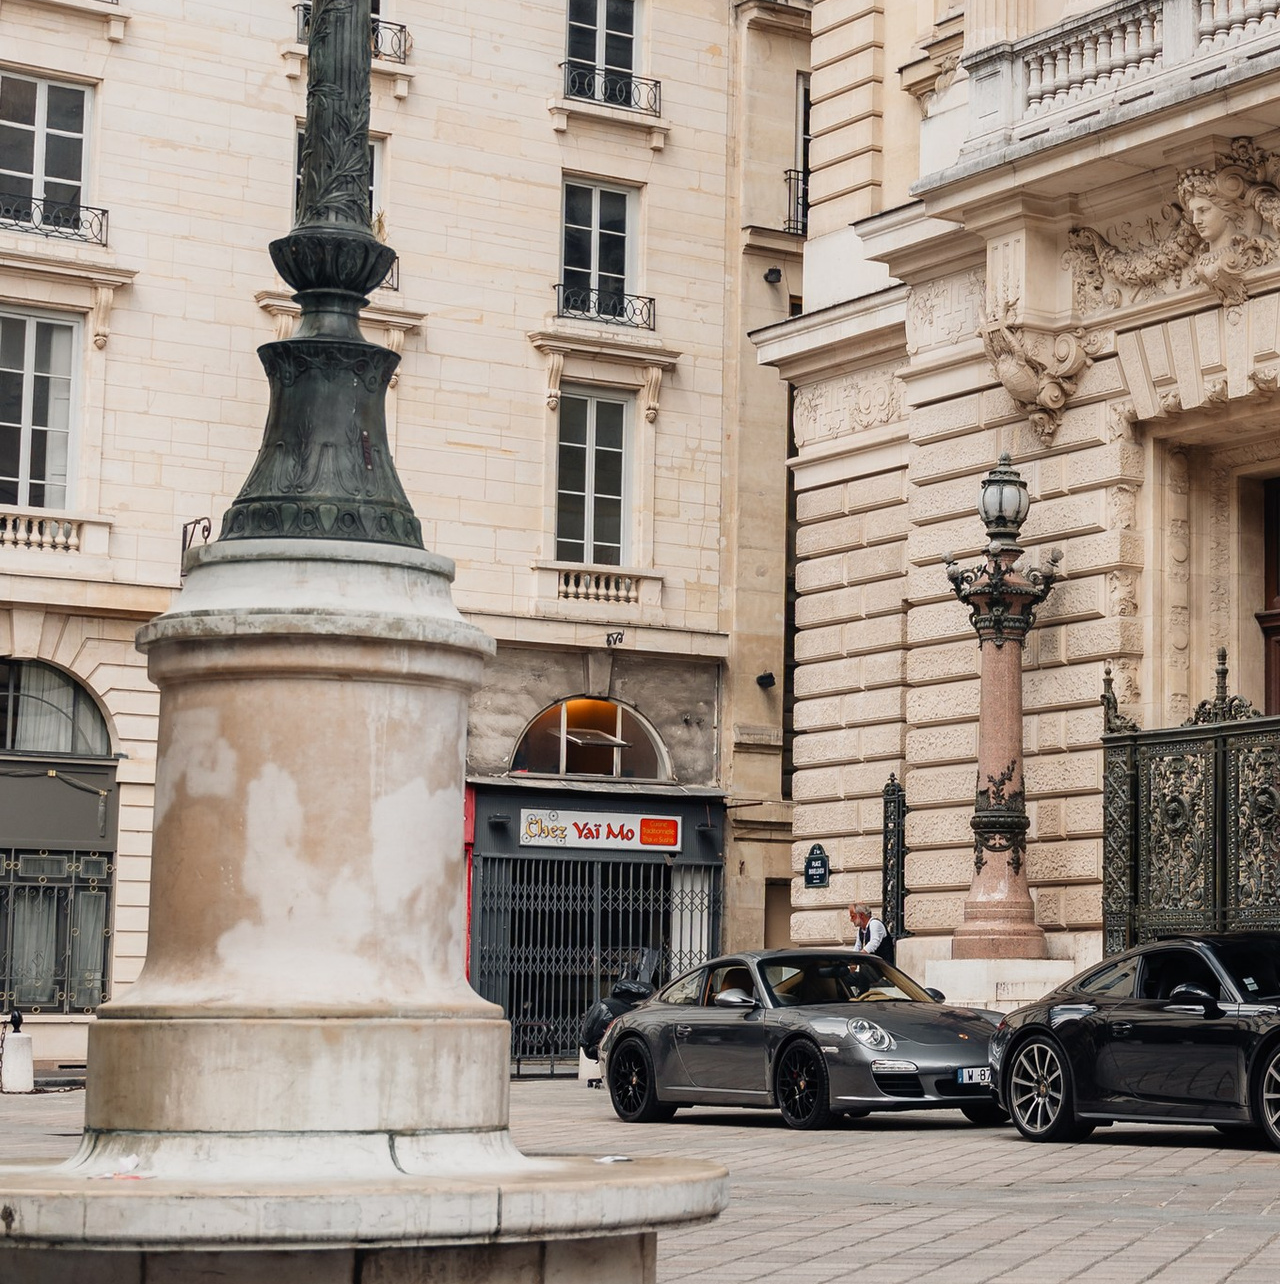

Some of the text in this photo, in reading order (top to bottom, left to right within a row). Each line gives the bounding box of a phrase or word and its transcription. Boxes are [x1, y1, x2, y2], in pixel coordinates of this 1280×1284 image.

[526, 818, 635, 841] Chez Yaï Mo
